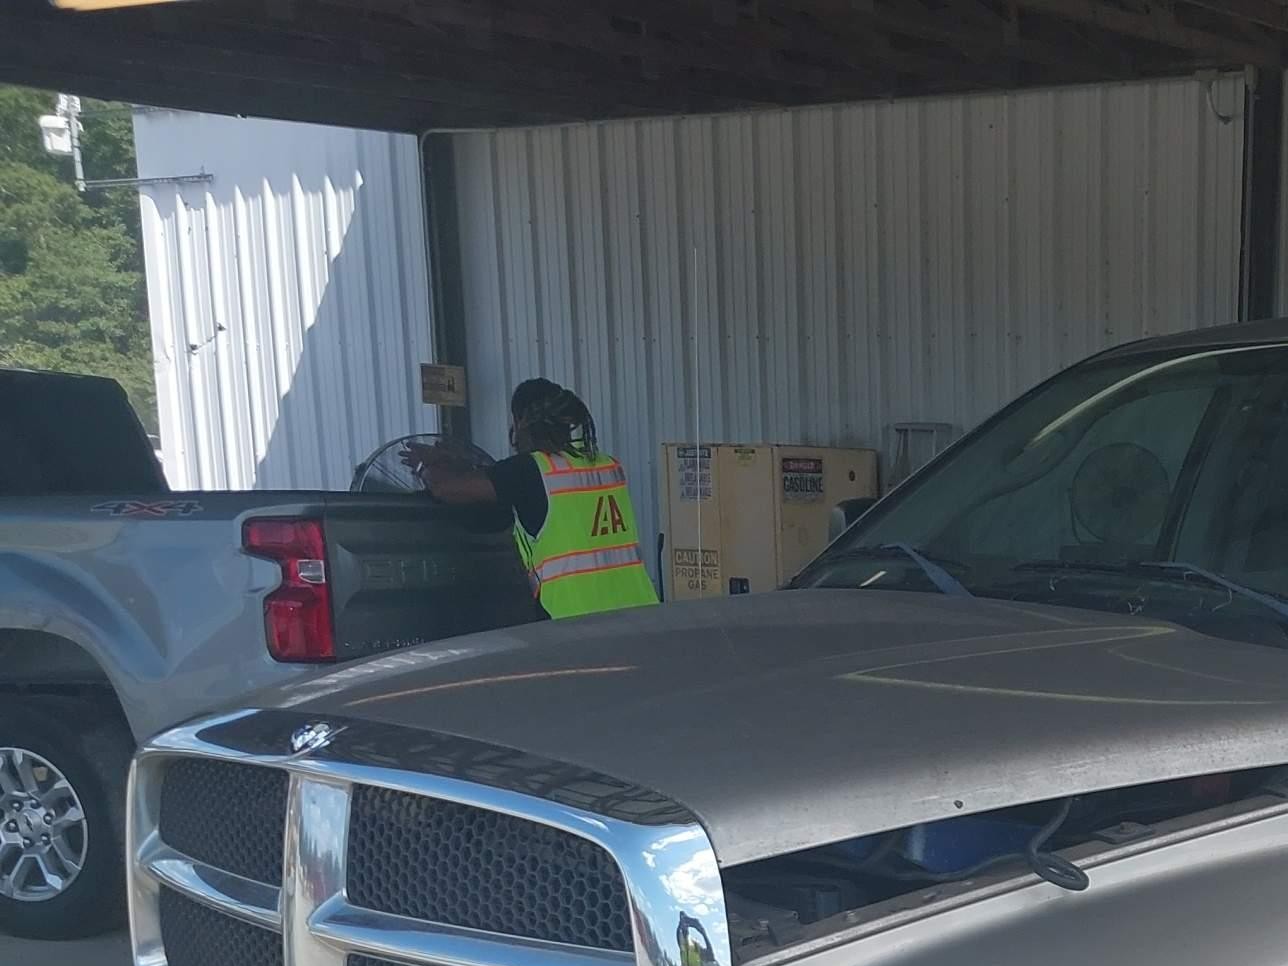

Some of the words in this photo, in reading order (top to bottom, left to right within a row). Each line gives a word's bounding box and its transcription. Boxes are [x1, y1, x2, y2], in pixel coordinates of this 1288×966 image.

[783, 475, 824, 493] GASOLINE
[675, 567, 720, 580] PROPANE
[687, 580, 707, 591] GAS
